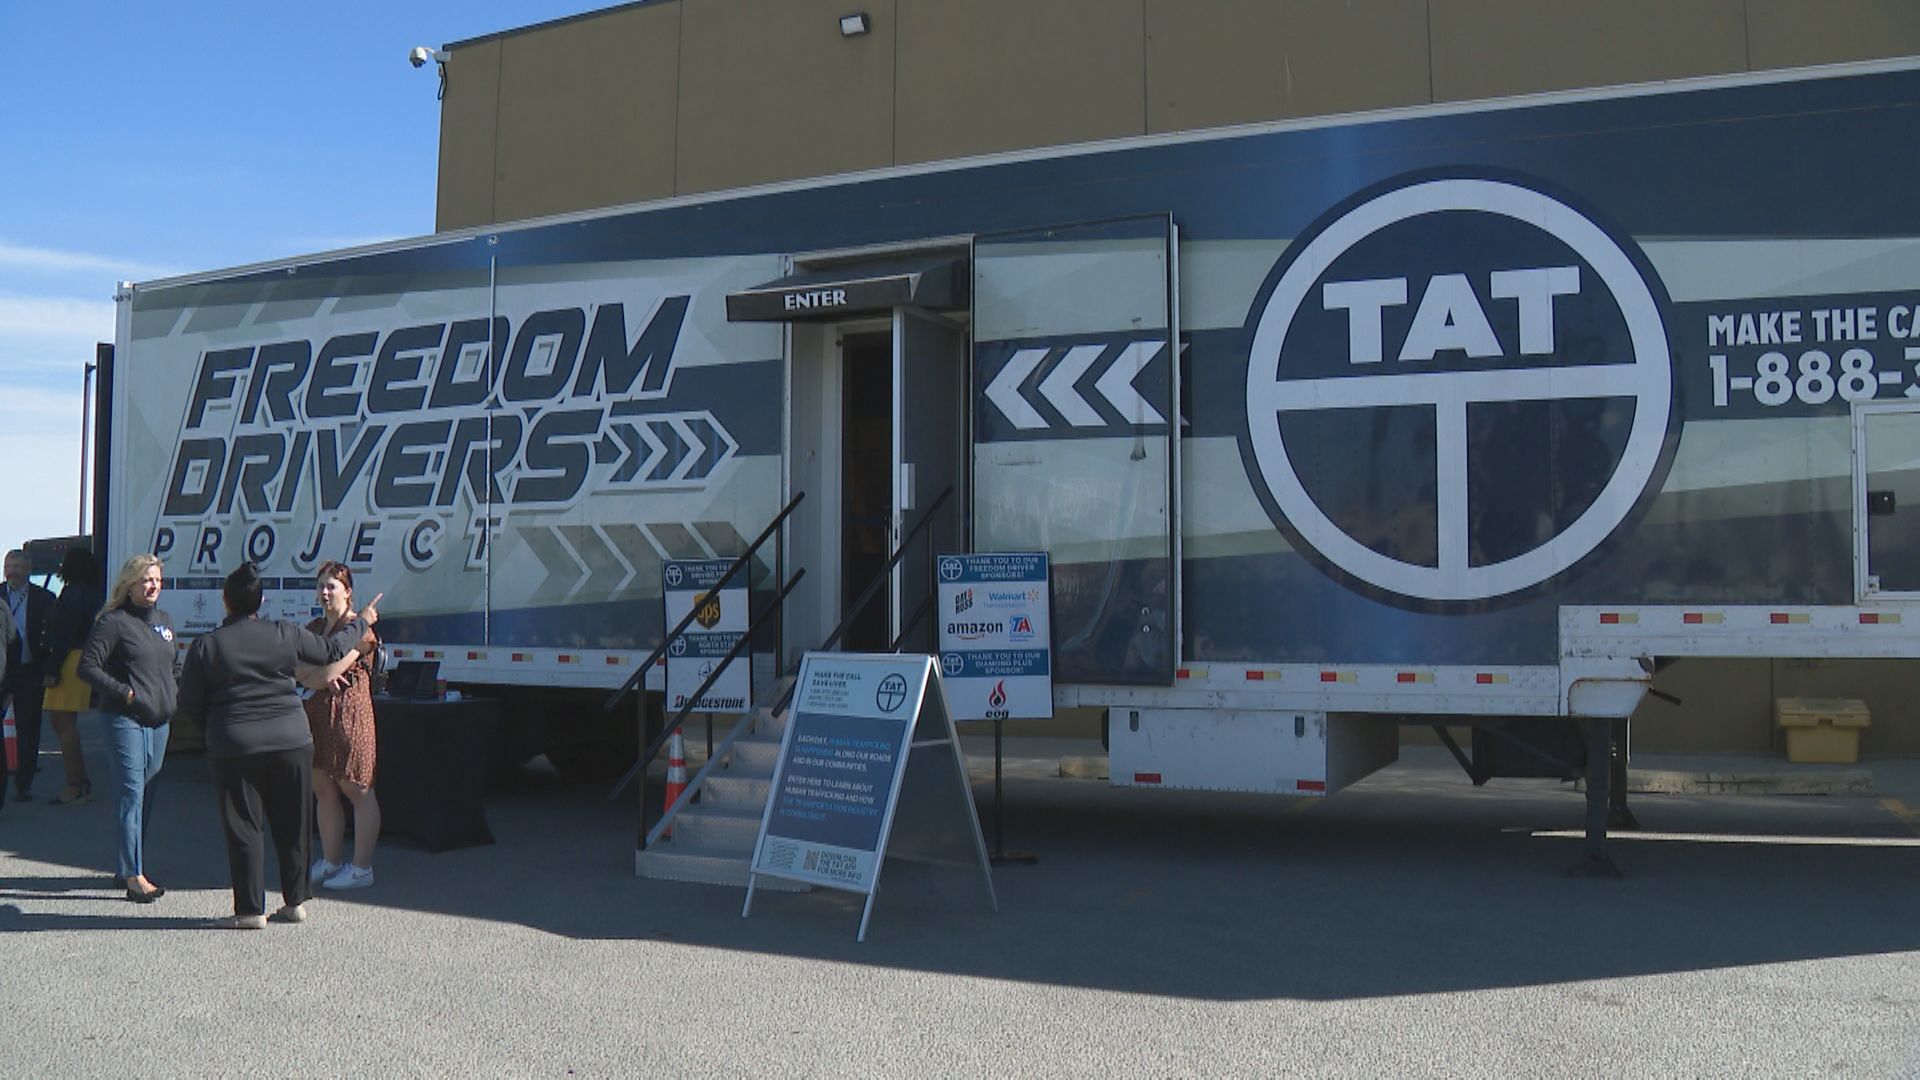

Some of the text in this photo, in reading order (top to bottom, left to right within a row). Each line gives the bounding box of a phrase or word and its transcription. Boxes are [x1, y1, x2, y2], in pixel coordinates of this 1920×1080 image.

[784, 289, 847, 311] ENTER
[1323, 265, 1581, 363] TAT
[1708, 311, 1802, 347] MAKE
[1811, 306, 1878, 343] THE
[185, 295, 690, 429] FREEDOM
[163, 408, 604, 517] DRIVERS
[154, 515, 503, 564] PROJECT
[967, 556, 1039, 565] THANK YOU TO OUR
[970, 563, 1035, 572] FREEDOM DRIVER
[989, 592, 1027, 602] Walmart
[947, 622, 1003, 634] amazon
[968, 654, 993, 662] THANK
[995, 653, 1011, 661] YOU
[1025, 652, 1041, 660] OUR
[976, 659, 1033, 669] DIAMOND PLUS
[884, 681, 904, 690] TAT
[673, 694, 746, 708] BDGESTONE
[986, 710, 1009, 720] eog
[834, 749, 855, 760] ALONG
[855, 752, 869, 761] OUR
[812, 758, 825, 767] OUR
